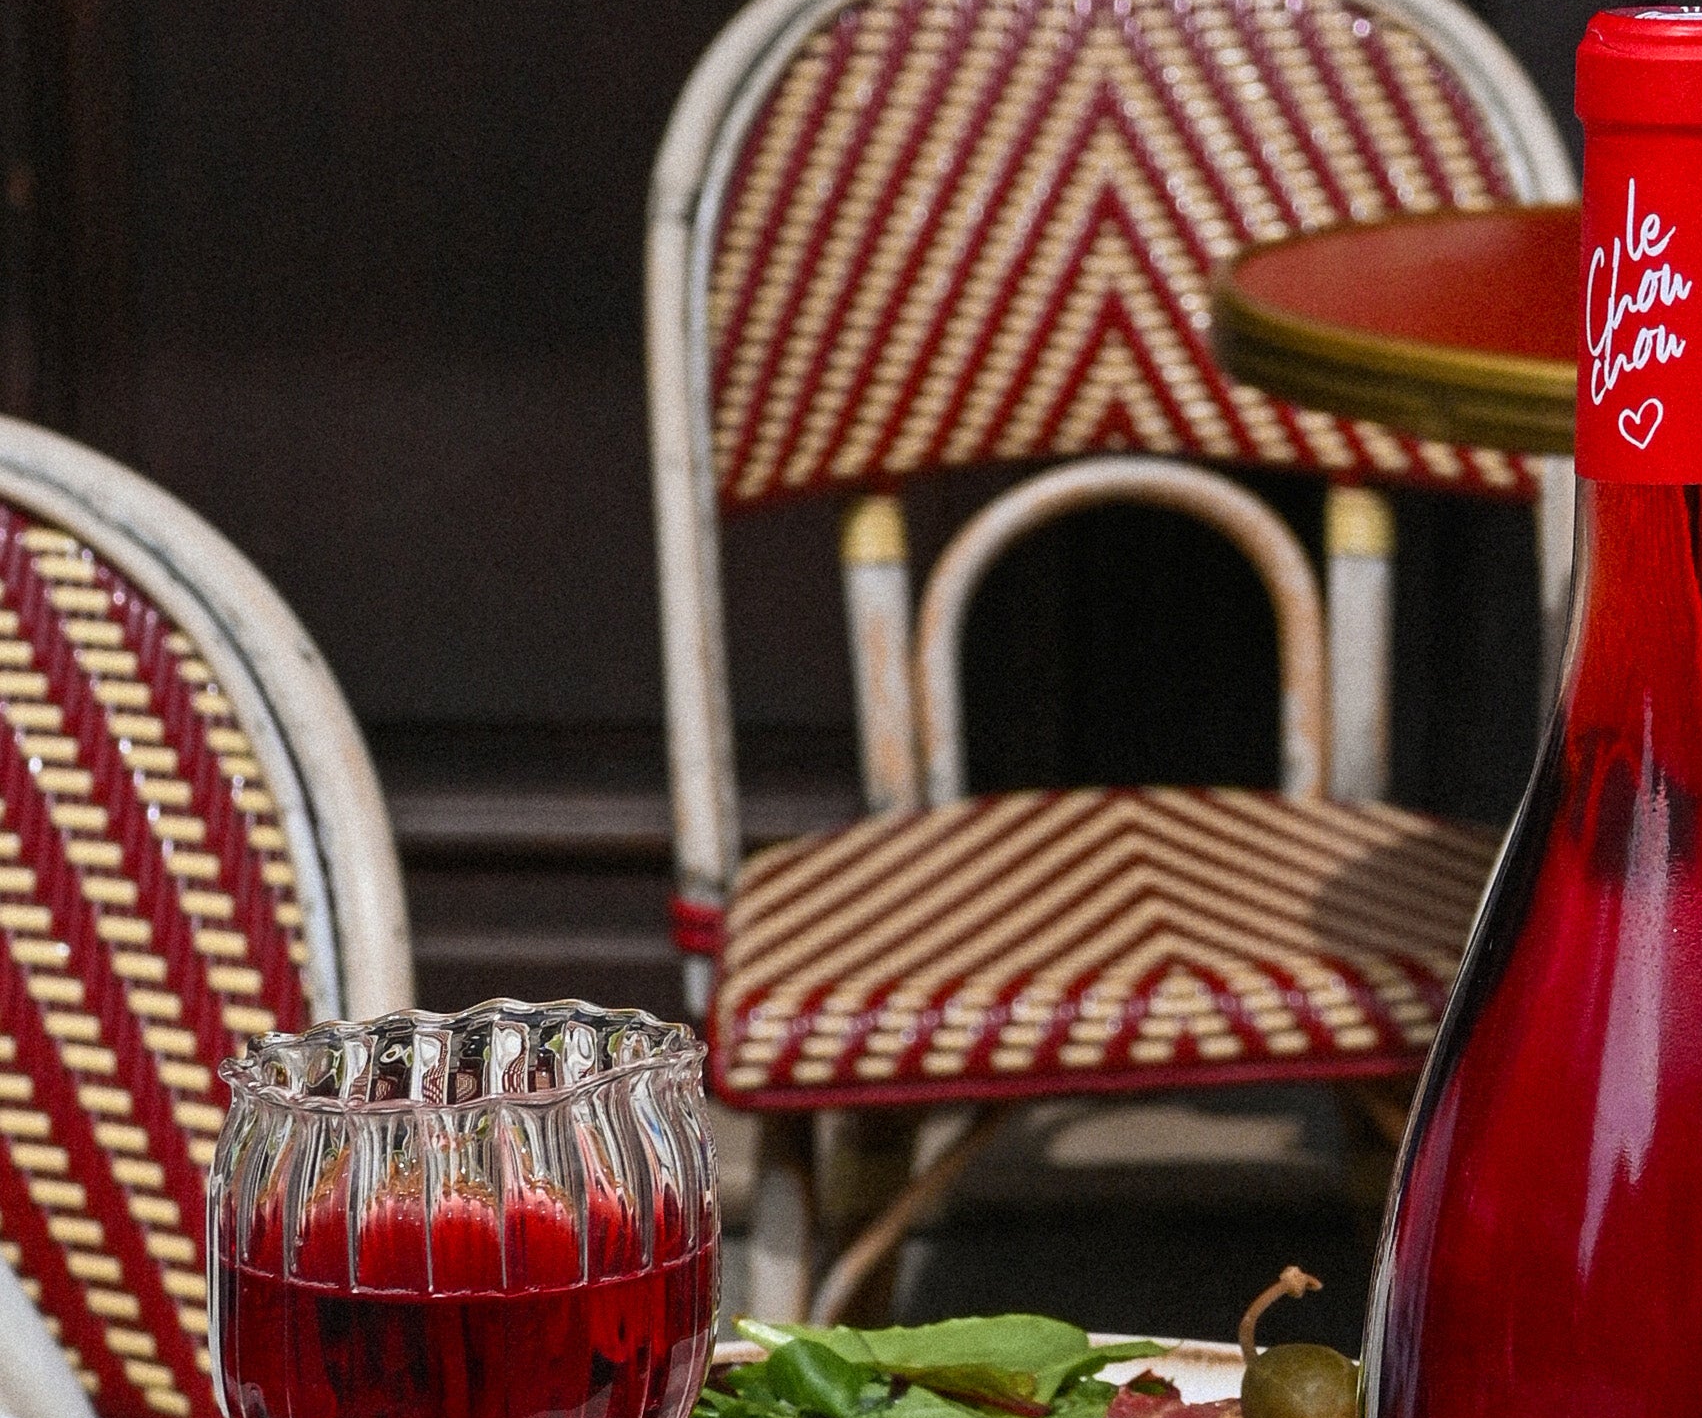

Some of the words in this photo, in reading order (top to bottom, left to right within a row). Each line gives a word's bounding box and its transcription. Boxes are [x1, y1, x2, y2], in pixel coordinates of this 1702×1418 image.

[1626, 178, 1676, 261] le
[1586, 237, 1693, 357] Chou
[1591, 299, 1687, 405] chou
